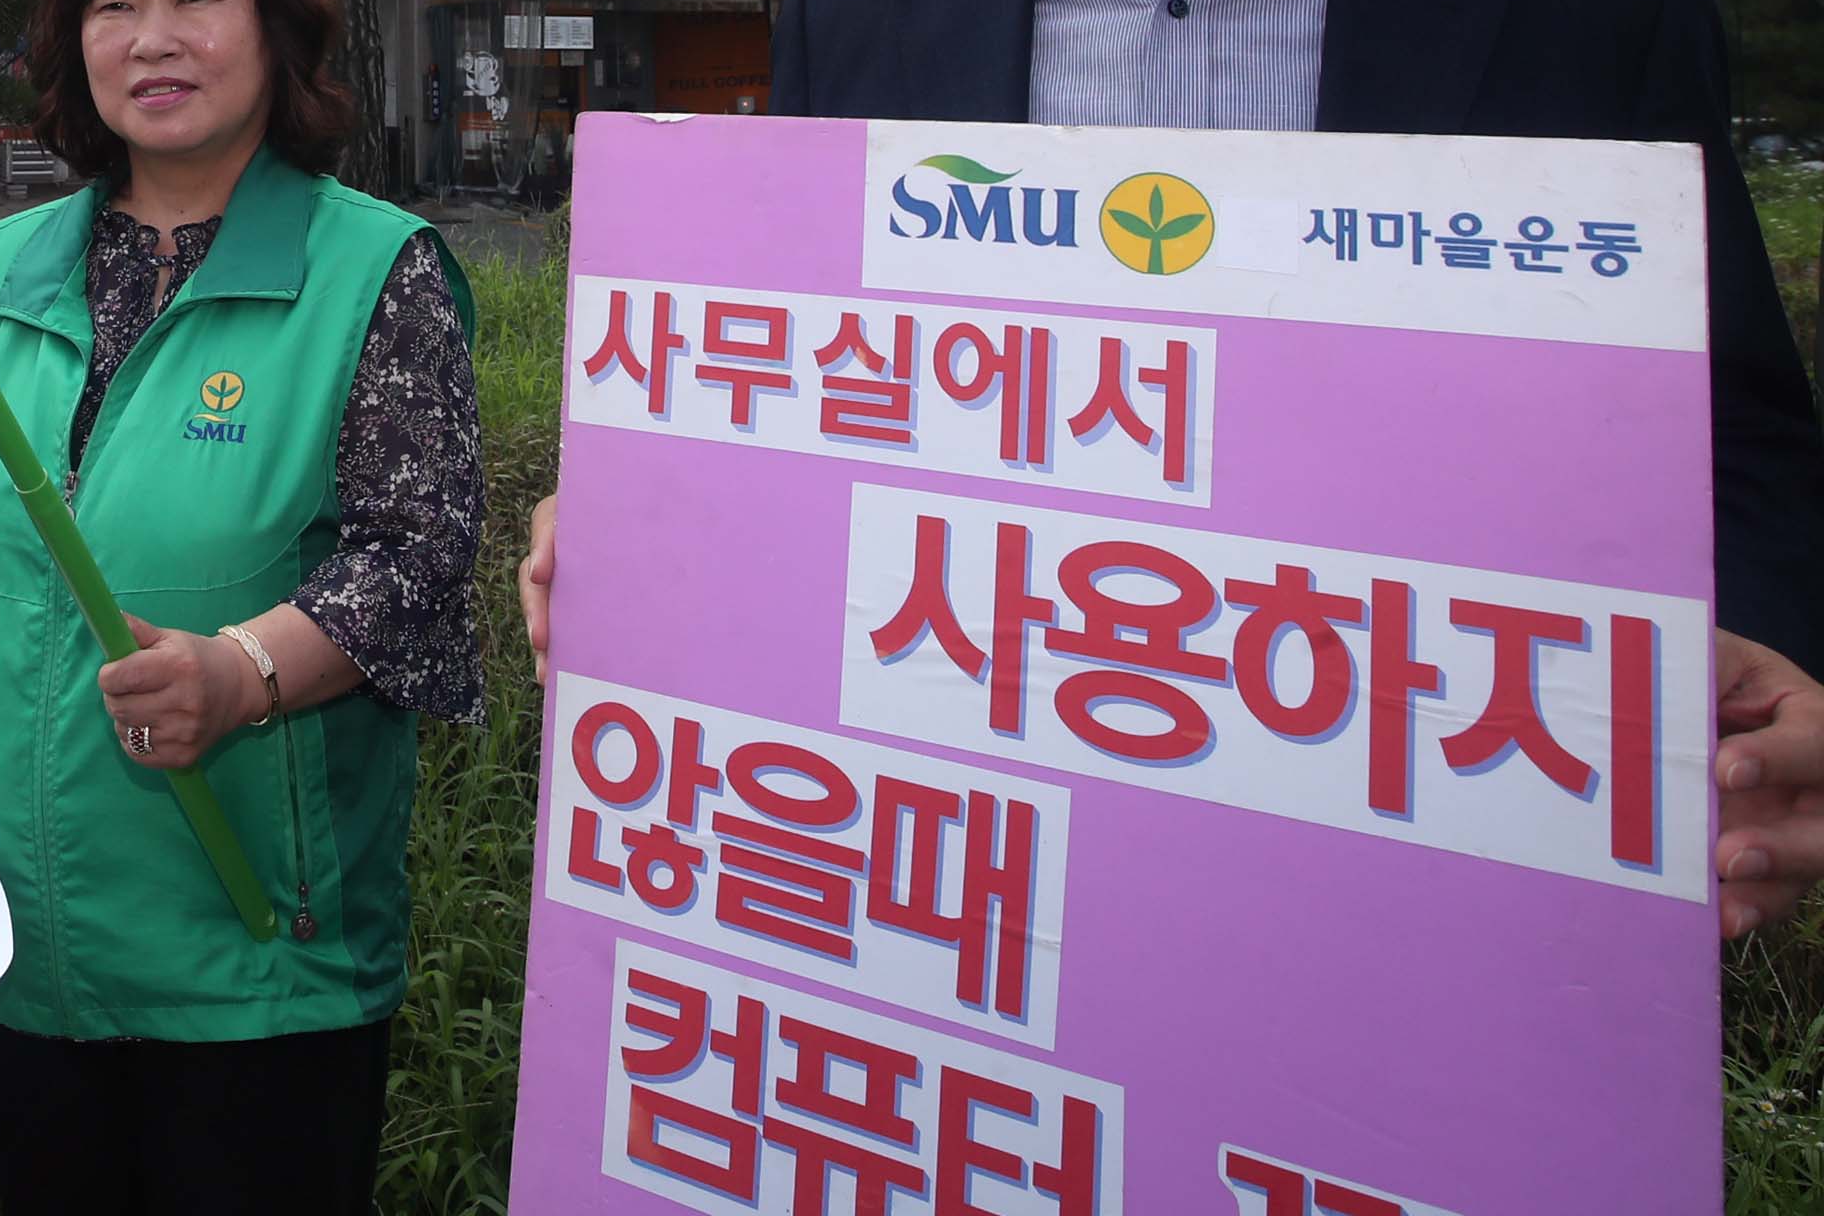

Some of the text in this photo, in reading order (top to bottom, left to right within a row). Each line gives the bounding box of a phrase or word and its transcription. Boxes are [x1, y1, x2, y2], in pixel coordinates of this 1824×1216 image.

[889, 172, 1078, 252] SMU
[1301, 208, 1644, 280] 새마을운동
[182, 418, 247, 444] SMU
[582, 290, 1198, 486] 사무실에서
[868, 512, 1662, 876] 사용하지
[568, 700, 1046, 1024] 않을때
[620, 967, 1111, 1216] 컴퓨터
